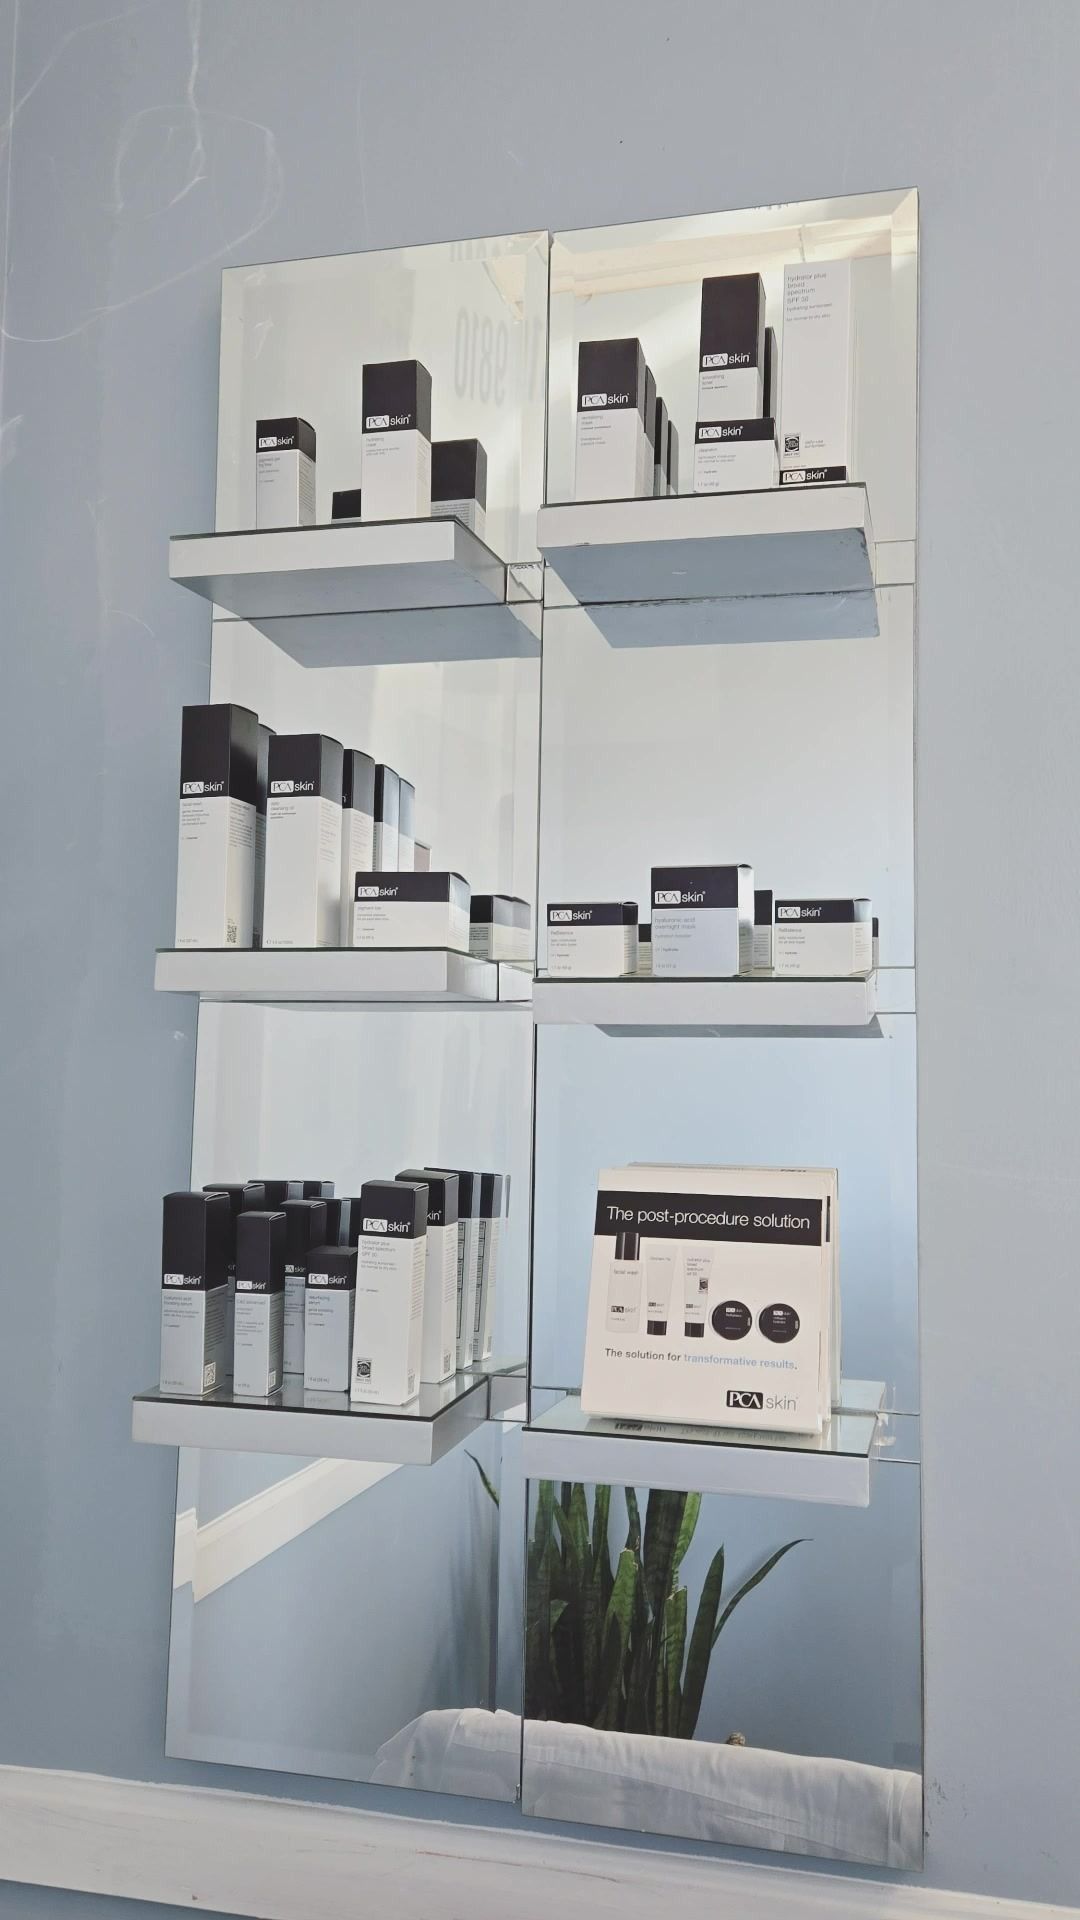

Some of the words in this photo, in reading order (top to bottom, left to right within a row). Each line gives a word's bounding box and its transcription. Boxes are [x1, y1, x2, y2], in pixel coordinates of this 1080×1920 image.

[704, 355, 727, 366] PCA
[583, 395, 606, 406] PCA
[608, 393, 629, 404] skin
[366, 416, 388, 428] PCA
[700, 428, 721, 438] PCA
[784, 472, 804, 482] PCA
[806, 470, 825, 480] skin
[184, 782, 203, 793] PCA
[204, 781, 223, 792] skin
[272, 782, 293, 793] PCA
[294, 781, 314, 792] skin
[359, 887, 378, 896] PCA
[379, 887, 398, 897] skin
[657, 892, 680, 903] PCA
[681, 891, 704, 903] skin
[552, 911, 571, 921] PCA
[572, 910, 591, 921] skin
[779, 907, 799, 917] PCA
[801, 907, 820, 917] skin
[606, 1205, 634, 1221] The
[637, 1208, 750, 1226] post-procedure
[753, 1213, 811, 1229] solution
[365, 1219, 387, 1231] PCA
[388, 1221, 409, 1233] skin
[183, 1275, 201, 1285] skin
[309, 1274, 327, 1284] PCA
[328, 1275, 346, 1285] skin
[604, 1347, 623, 1358] The
[625, 1349, 665, 1361] solution
[667, 1352, 681, 1362] for
[684, 1353, 757, 1367] transformative
[759, 1359, 798, 1371] results.
[729, 1391, 762, 1409] PCA
[766, 1394, 797, 1411] skin
